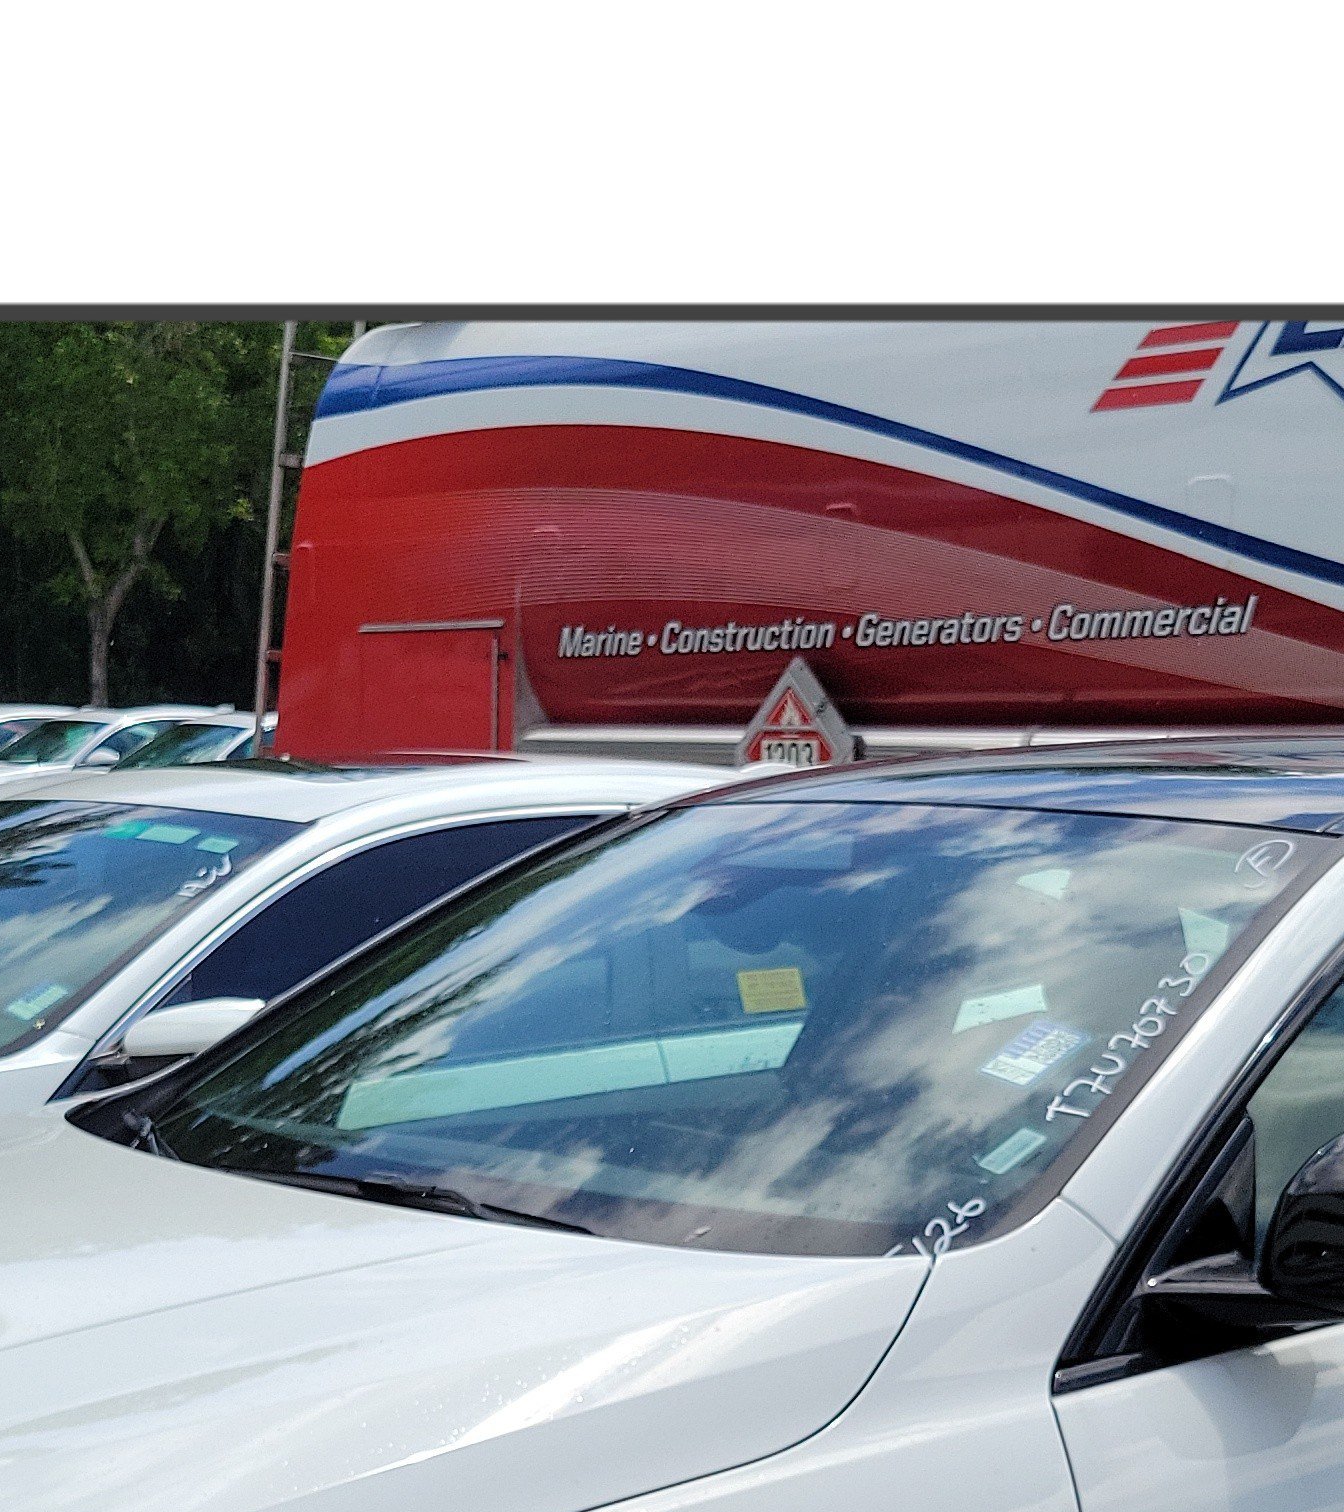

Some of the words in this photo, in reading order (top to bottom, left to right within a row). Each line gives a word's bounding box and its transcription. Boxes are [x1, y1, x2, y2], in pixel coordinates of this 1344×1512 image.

[558, 626, 644, 658] Marine
[660, 617, 835, 655] Construction
[855, 612, 1024, 647] Generators
[1047, 594, 1259, 642] Commercial
